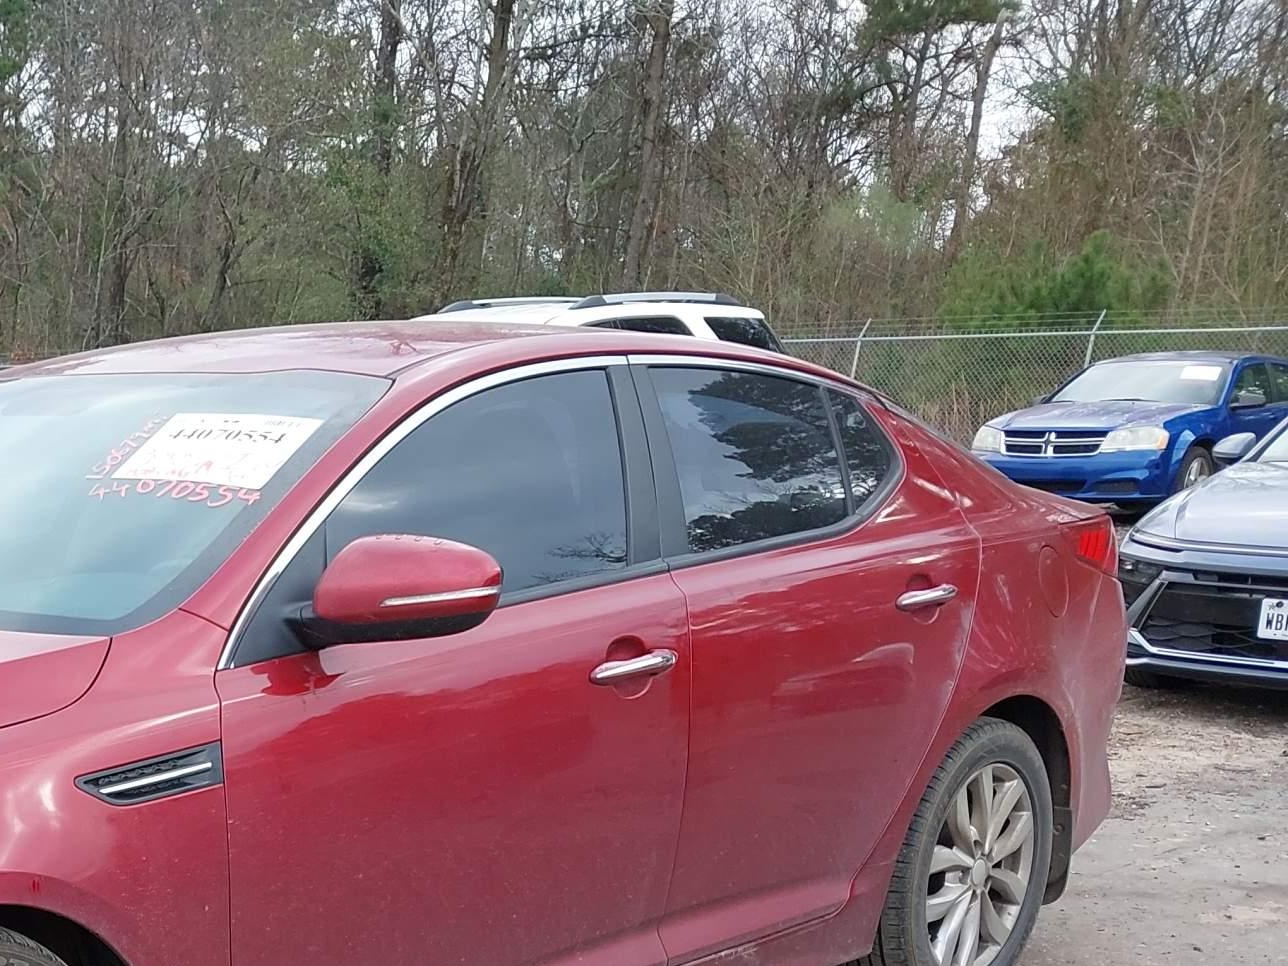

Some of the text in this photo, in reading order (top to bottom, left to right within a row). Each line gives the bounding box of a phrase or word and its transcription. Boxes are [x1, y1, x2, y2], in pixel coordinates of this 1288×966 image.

[169, 429, 287, 444] 44070554
[88, 479, 261, 507] 44070554
[1265, 612, 1288, 631] WB
